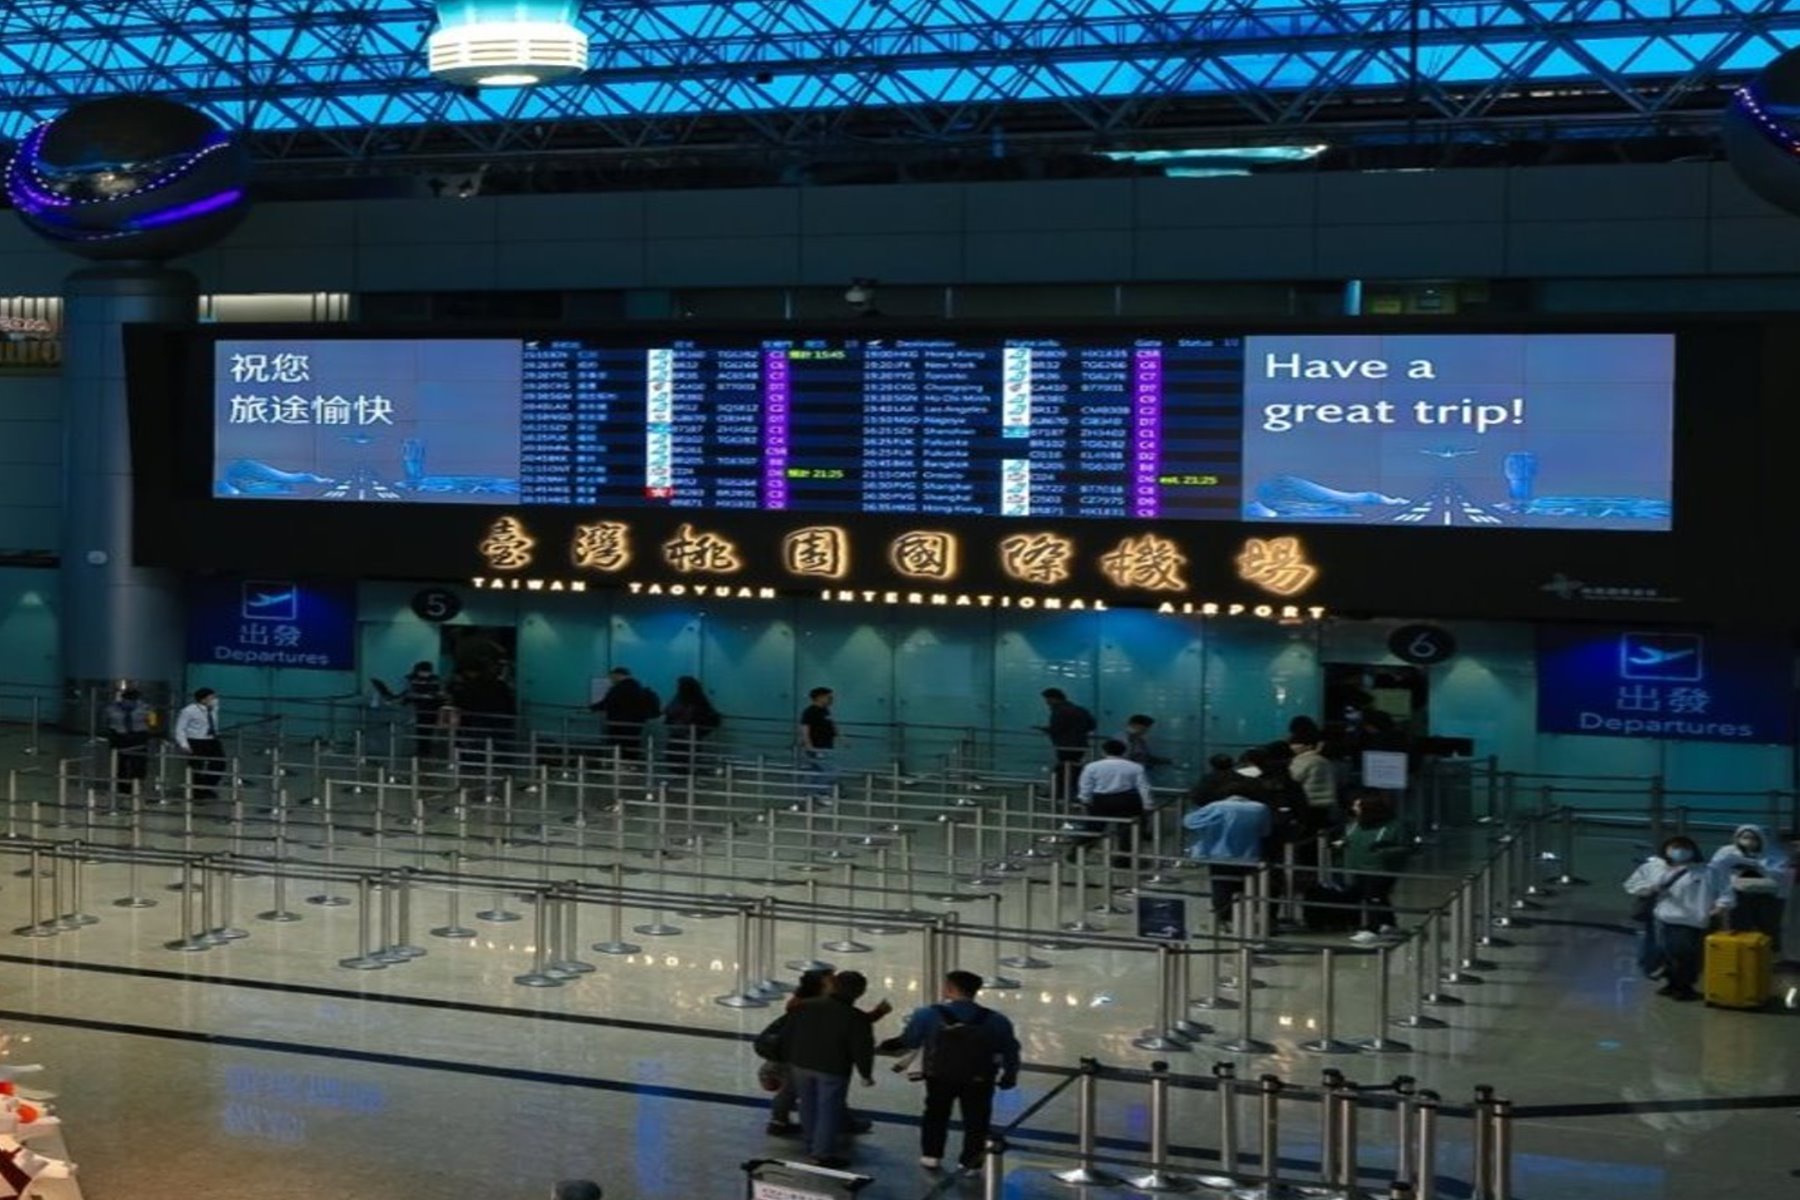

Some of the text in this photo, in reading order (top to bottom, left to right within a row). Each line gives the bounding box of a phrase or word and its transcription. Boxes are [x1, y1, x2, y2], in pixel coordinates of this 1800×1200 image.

[230, 353, 310, 383] 祝您
[1266, 353, 1437, 379] Have a
[230, 394, 394, 425] 旅途愉快
[1263, 398, 1524, 434] great trip!
[426, 594, 447, 616] 5
[472, 577, 1327, 619] TAIWAN TAOYUAN INTERNATIONAL AIRPORT
[240, 623, 301, 646] 出發
[1409, 632, 1437, 657] 6
[214, 645, 332, 666] Departures
[1616, 684, 1710, 713] 出發
[1580, 712, 1753, 737] Departures
